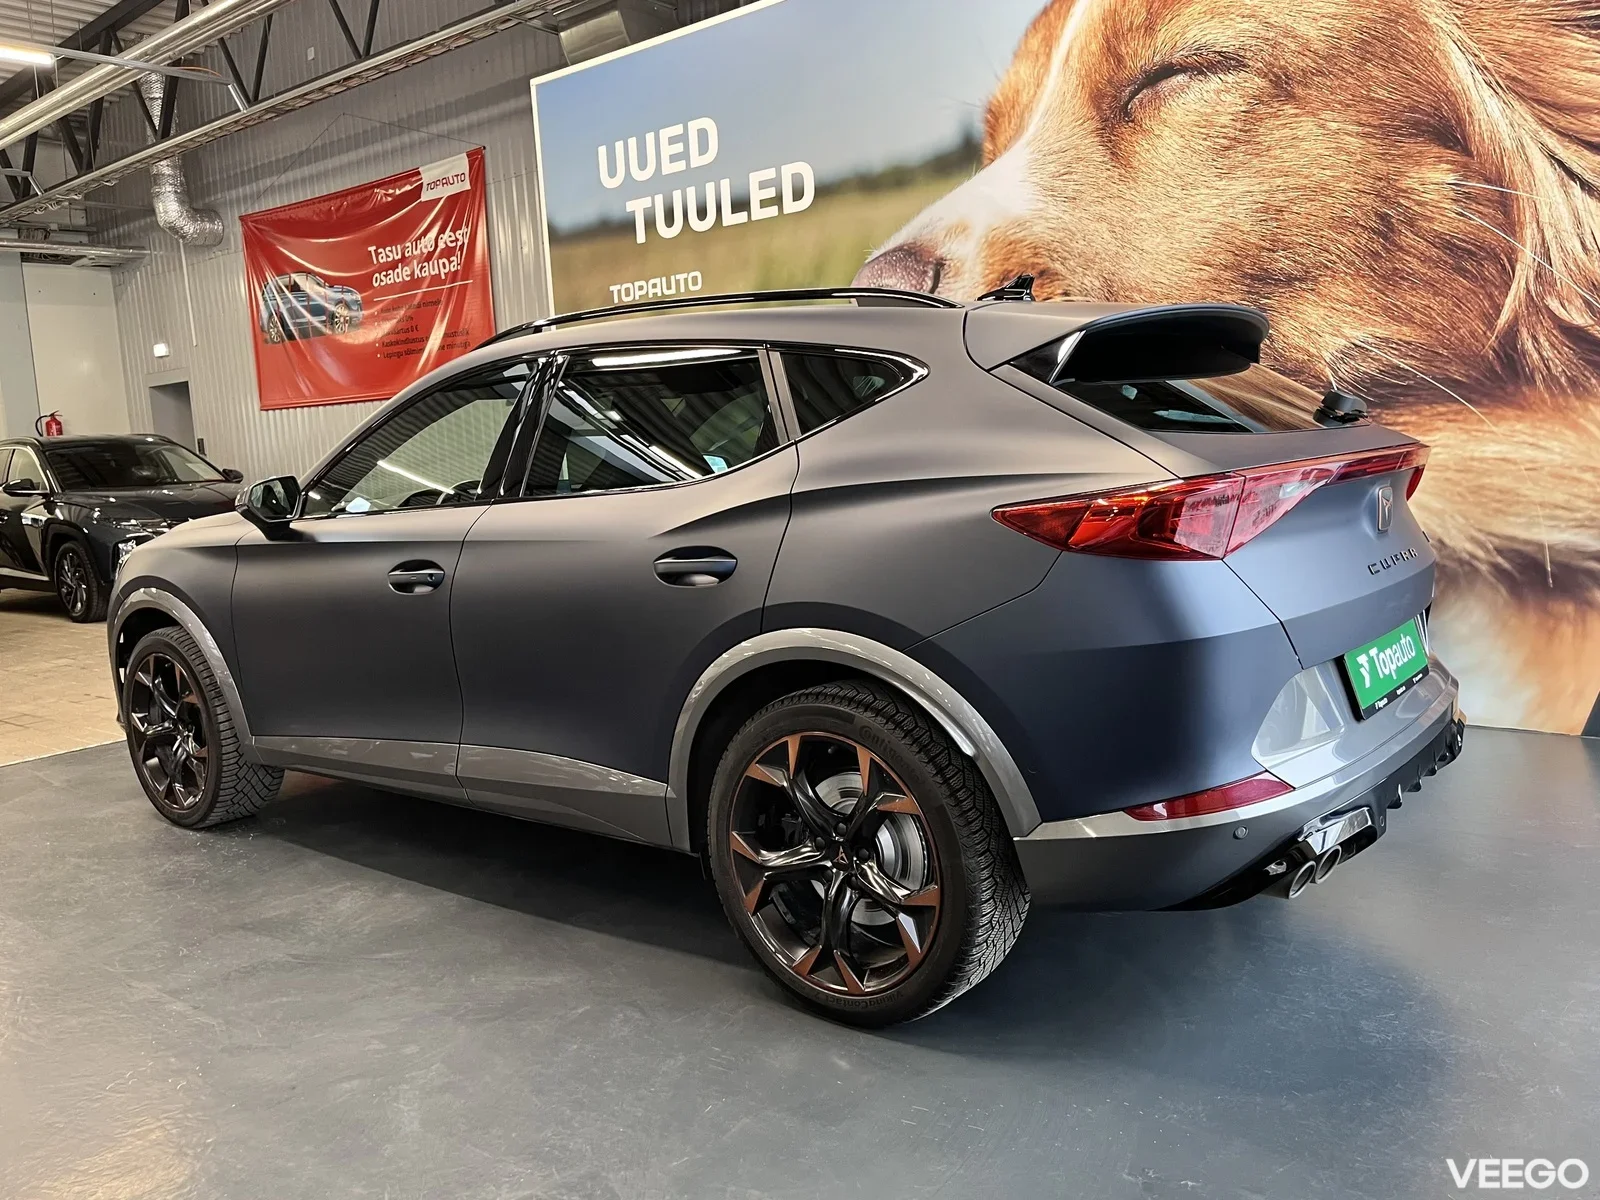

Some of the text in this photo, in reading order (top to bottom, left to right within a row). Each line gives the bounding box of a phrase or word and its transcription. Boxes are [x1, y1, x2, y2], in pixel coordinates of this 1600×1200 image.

[597, 116, 719, 189] UUED
[426, 172, 466, 191] TOPAUTO
[625, 161, 816, 244] TUULED
[368, 226, 468, 265] Tasu auto eest
[372, 251, 461, 287] osade kaupa!
[609, 270, 703, 304] TOPAUTO
[1367, 548, 1418, 575] CUPRA
[1368, 633, 1416, 680] Topauto
